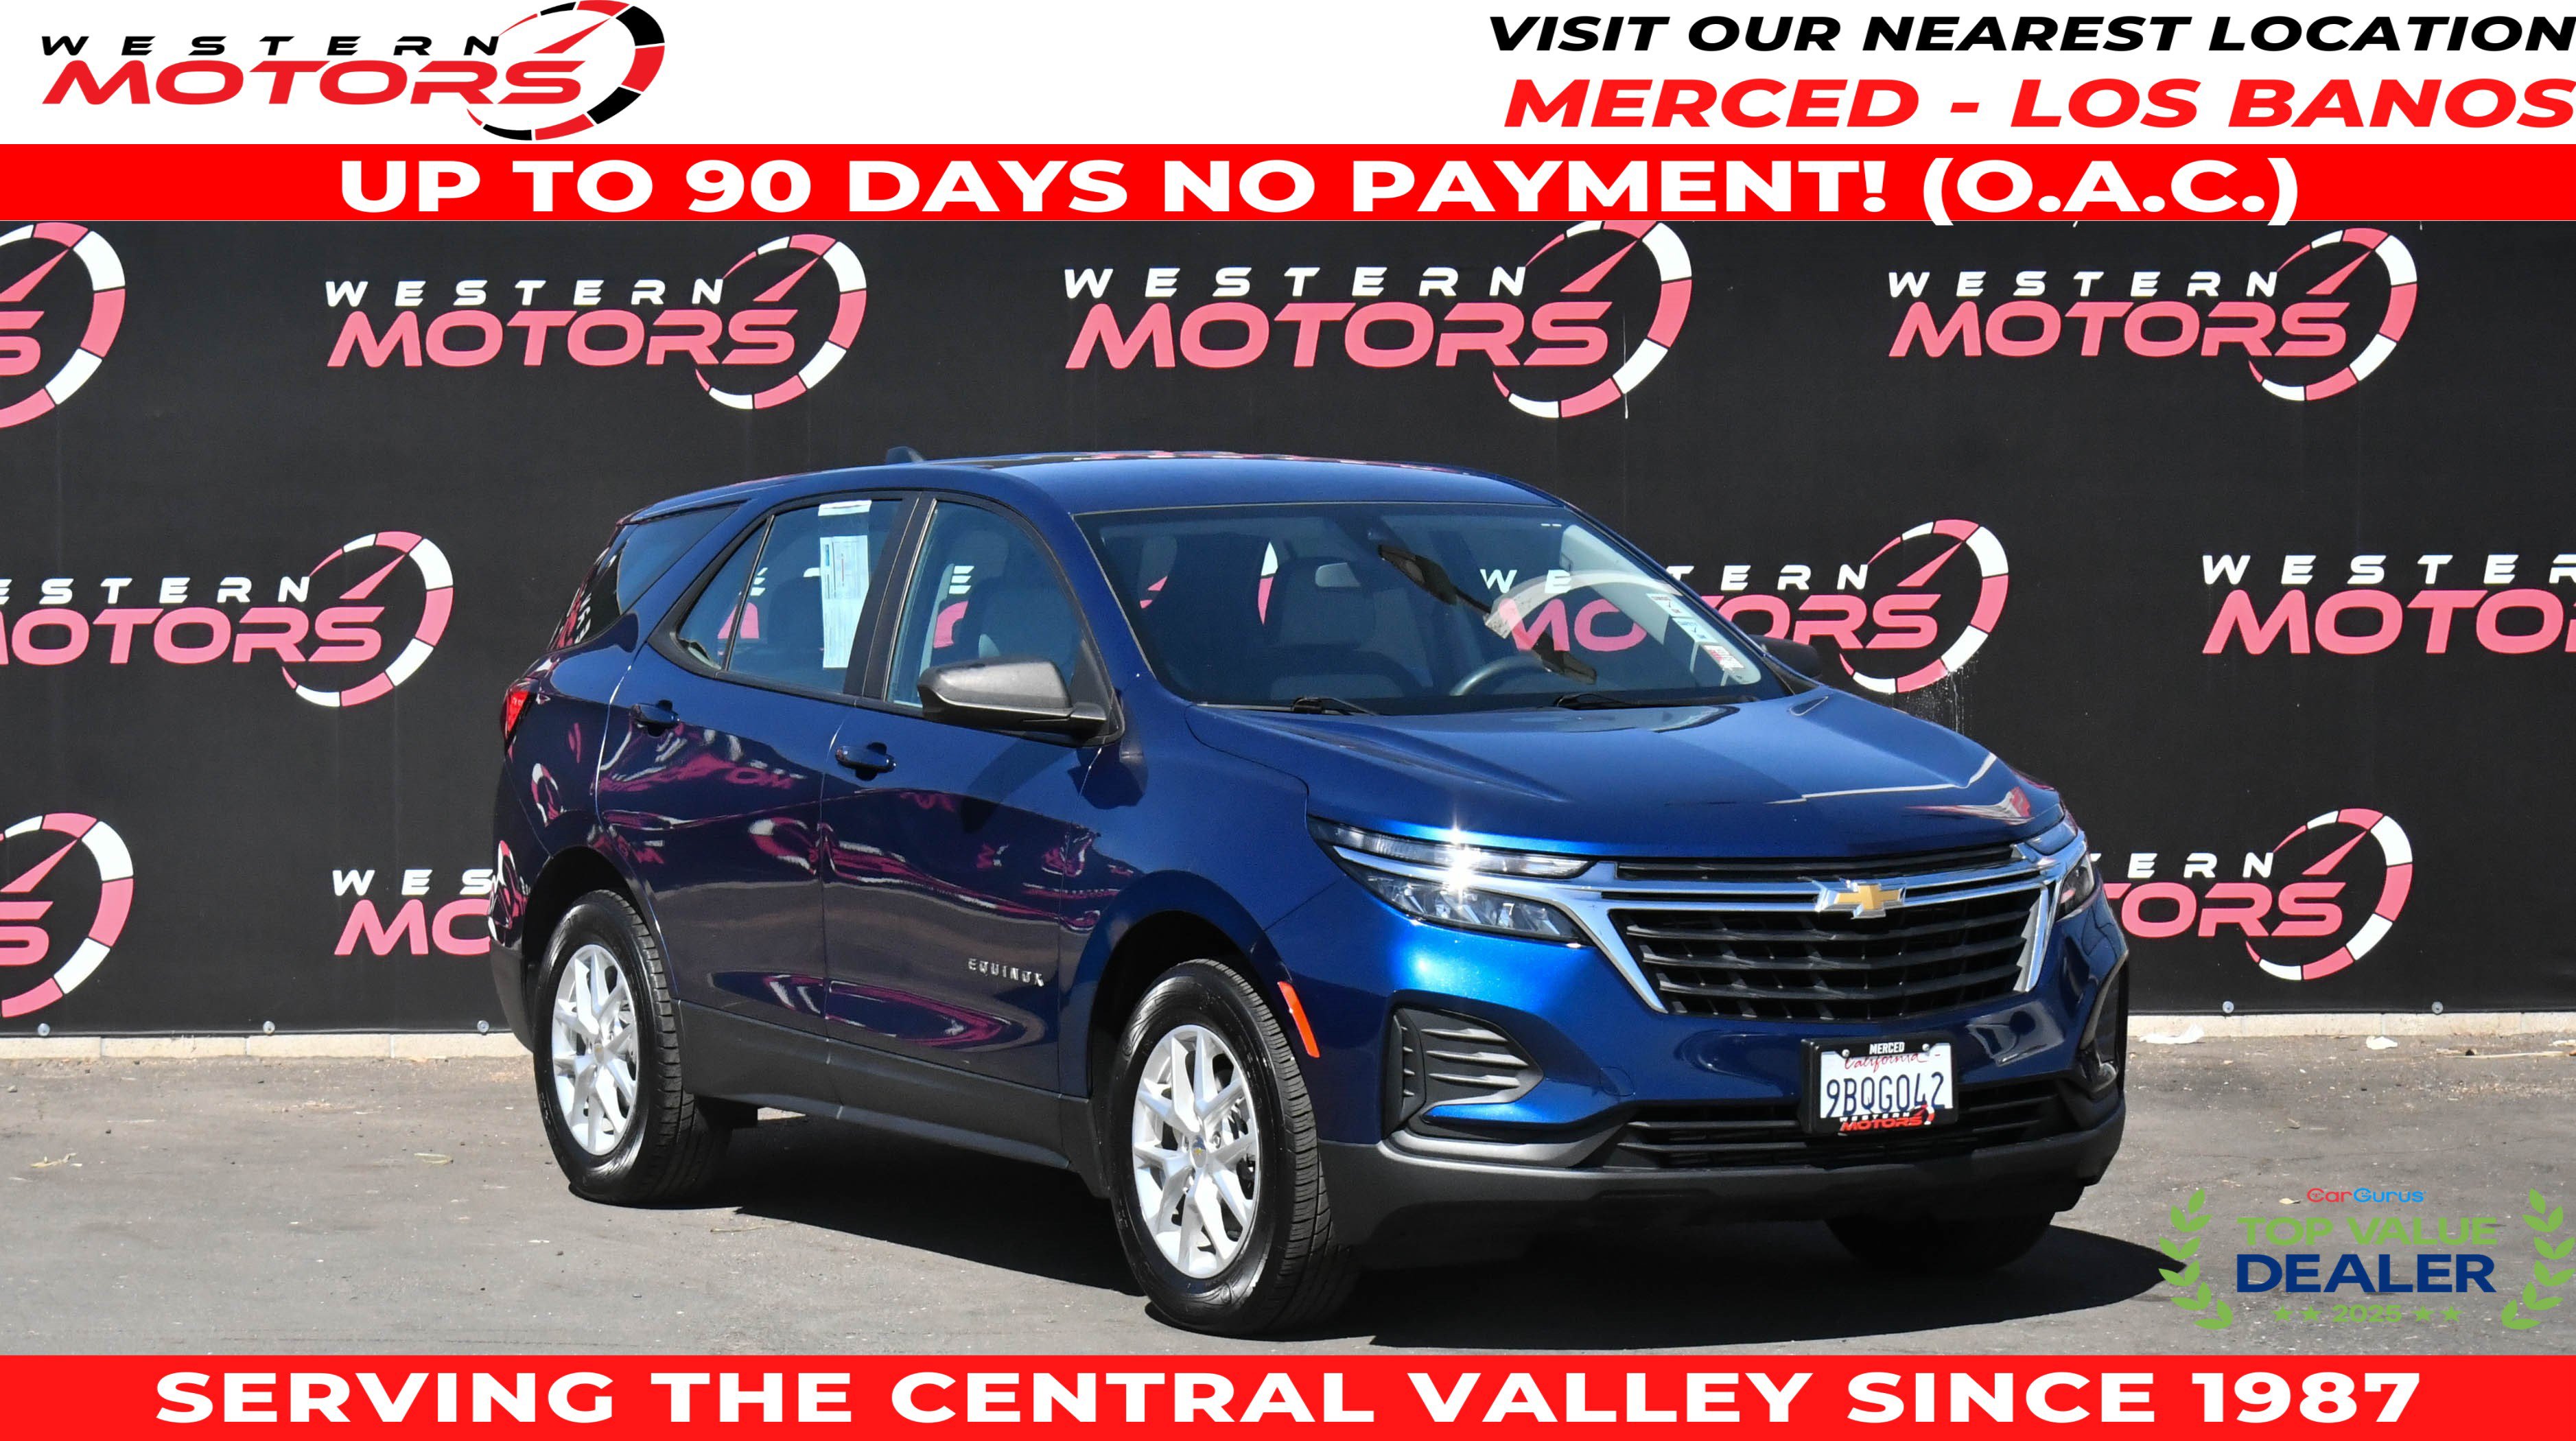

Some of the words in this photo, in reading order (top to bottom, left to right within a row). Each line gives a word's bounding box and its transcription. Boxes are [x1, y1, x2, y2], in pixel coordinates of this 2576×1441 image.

[325, 278, 724, 307] WESTERN
[1064, 266, 1526, 298] WESTERN
[1888, 270, 2278, 298] WESTERN
[327, 309, 798, 368] MOTORS
[1065, 301, 1613, 370] MOTORS
[1888, 300, 2350, 358] MOTORS
[968, 958, 1044, 987] EQUINOX
[1869, 1042, 1905, 1055] MERCED
[1827, 1071, 1945, 1118] 9BQG042
[1840, 1116, 1923, 1132] MOTORS
